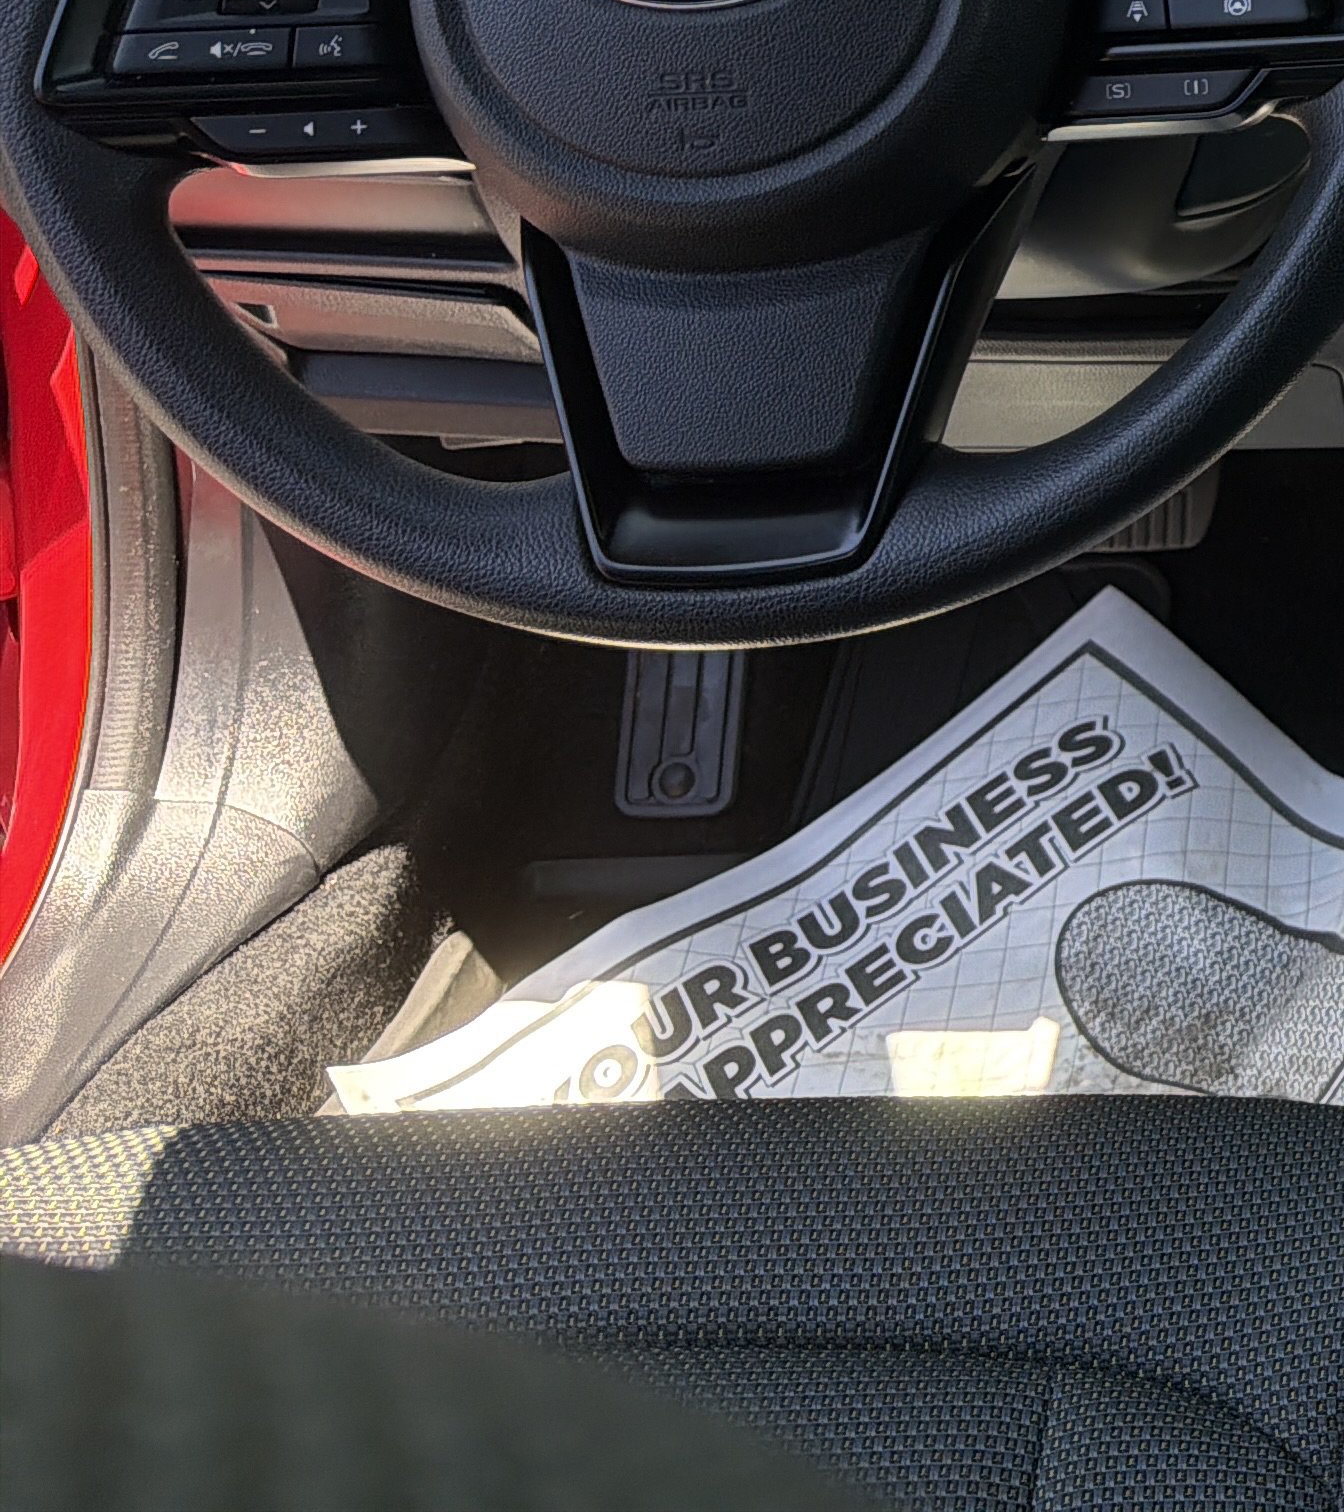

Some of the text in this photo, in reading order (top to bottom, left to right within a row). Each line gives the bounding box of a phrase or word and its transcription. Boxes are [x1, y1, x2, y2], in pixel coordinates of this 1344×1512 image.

[647, 94, 748, 111] AIRBAG
[659, 72, 737, 91] SRS
[664, 746, 1190, 1100] PPRECIATED!
[748, 719, 1118, 988] BUSINESS
